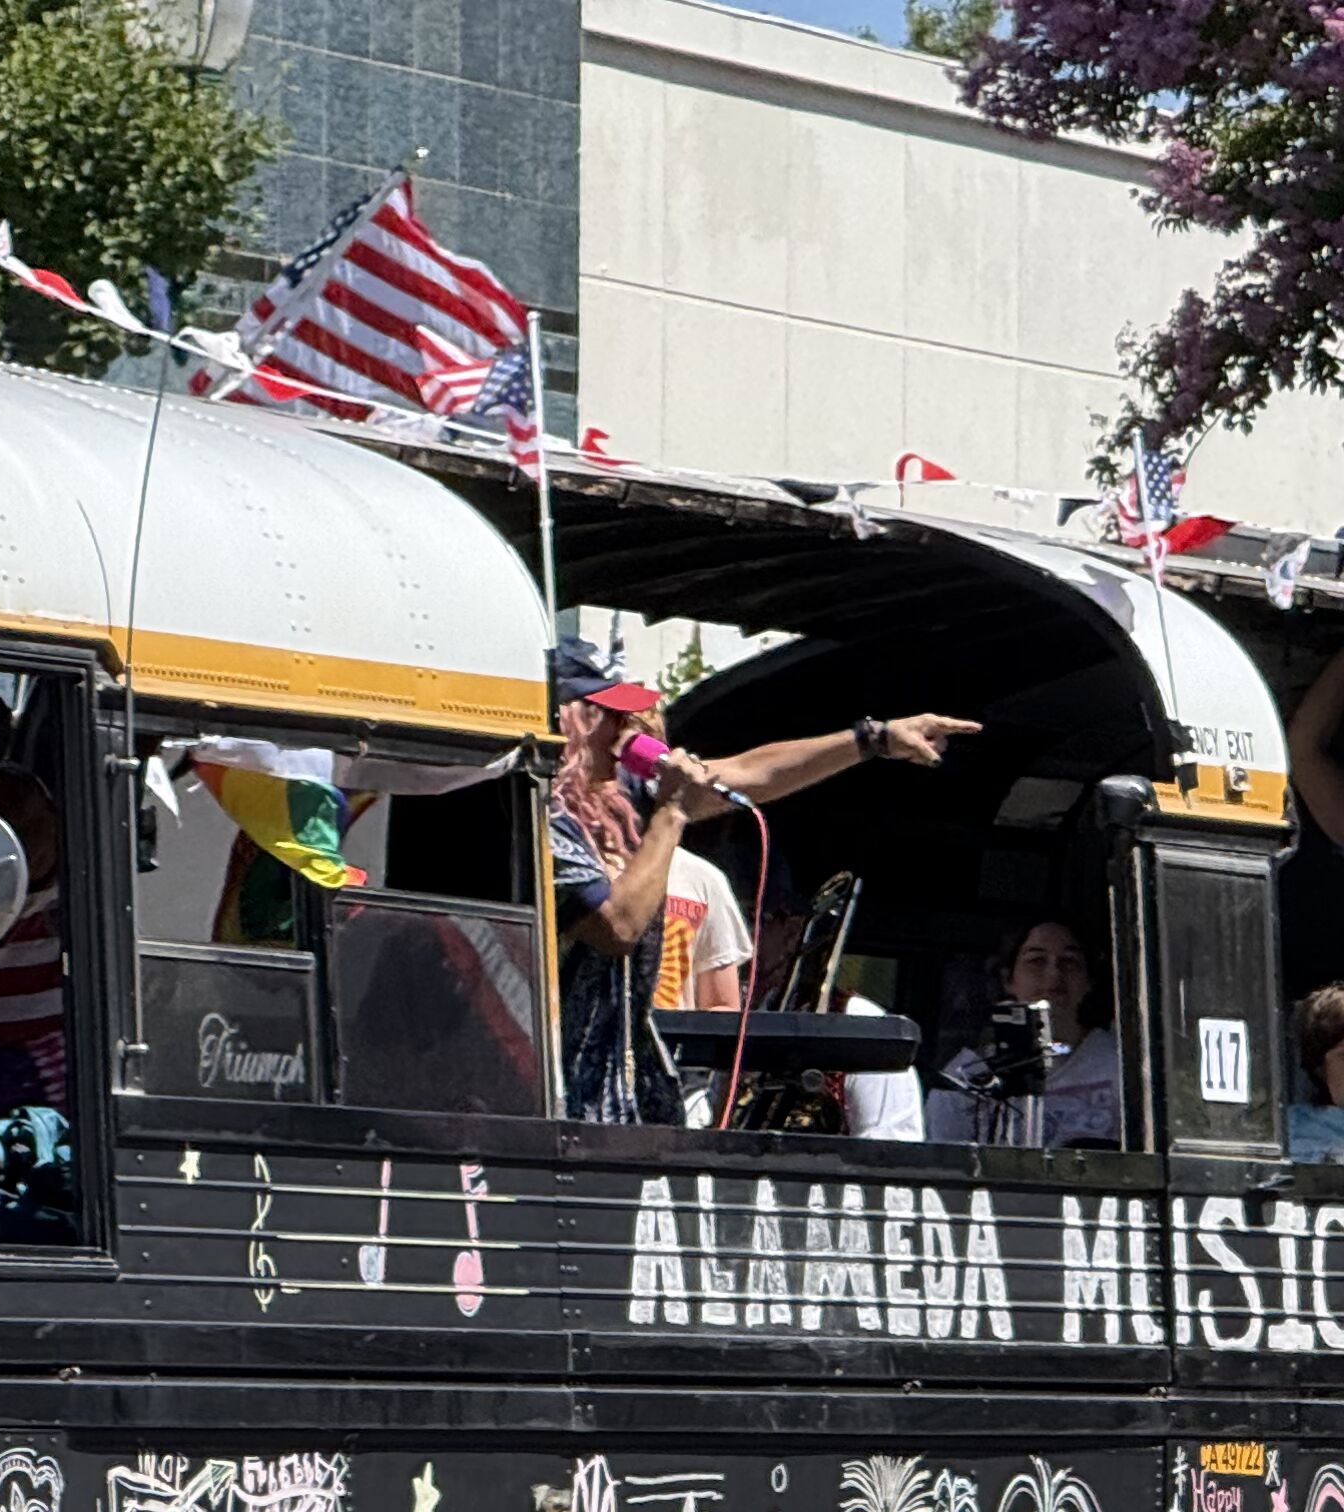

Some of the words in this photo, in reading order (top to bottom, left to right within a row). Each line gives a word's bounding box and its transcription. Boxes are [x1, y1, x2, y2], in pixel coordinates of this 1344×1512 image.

[1225, 729, 1255, 762] EXIT
[1202, 1029, 1244, 1093] 117
[628, 1175, 1013, 1341] ALAMEDA
